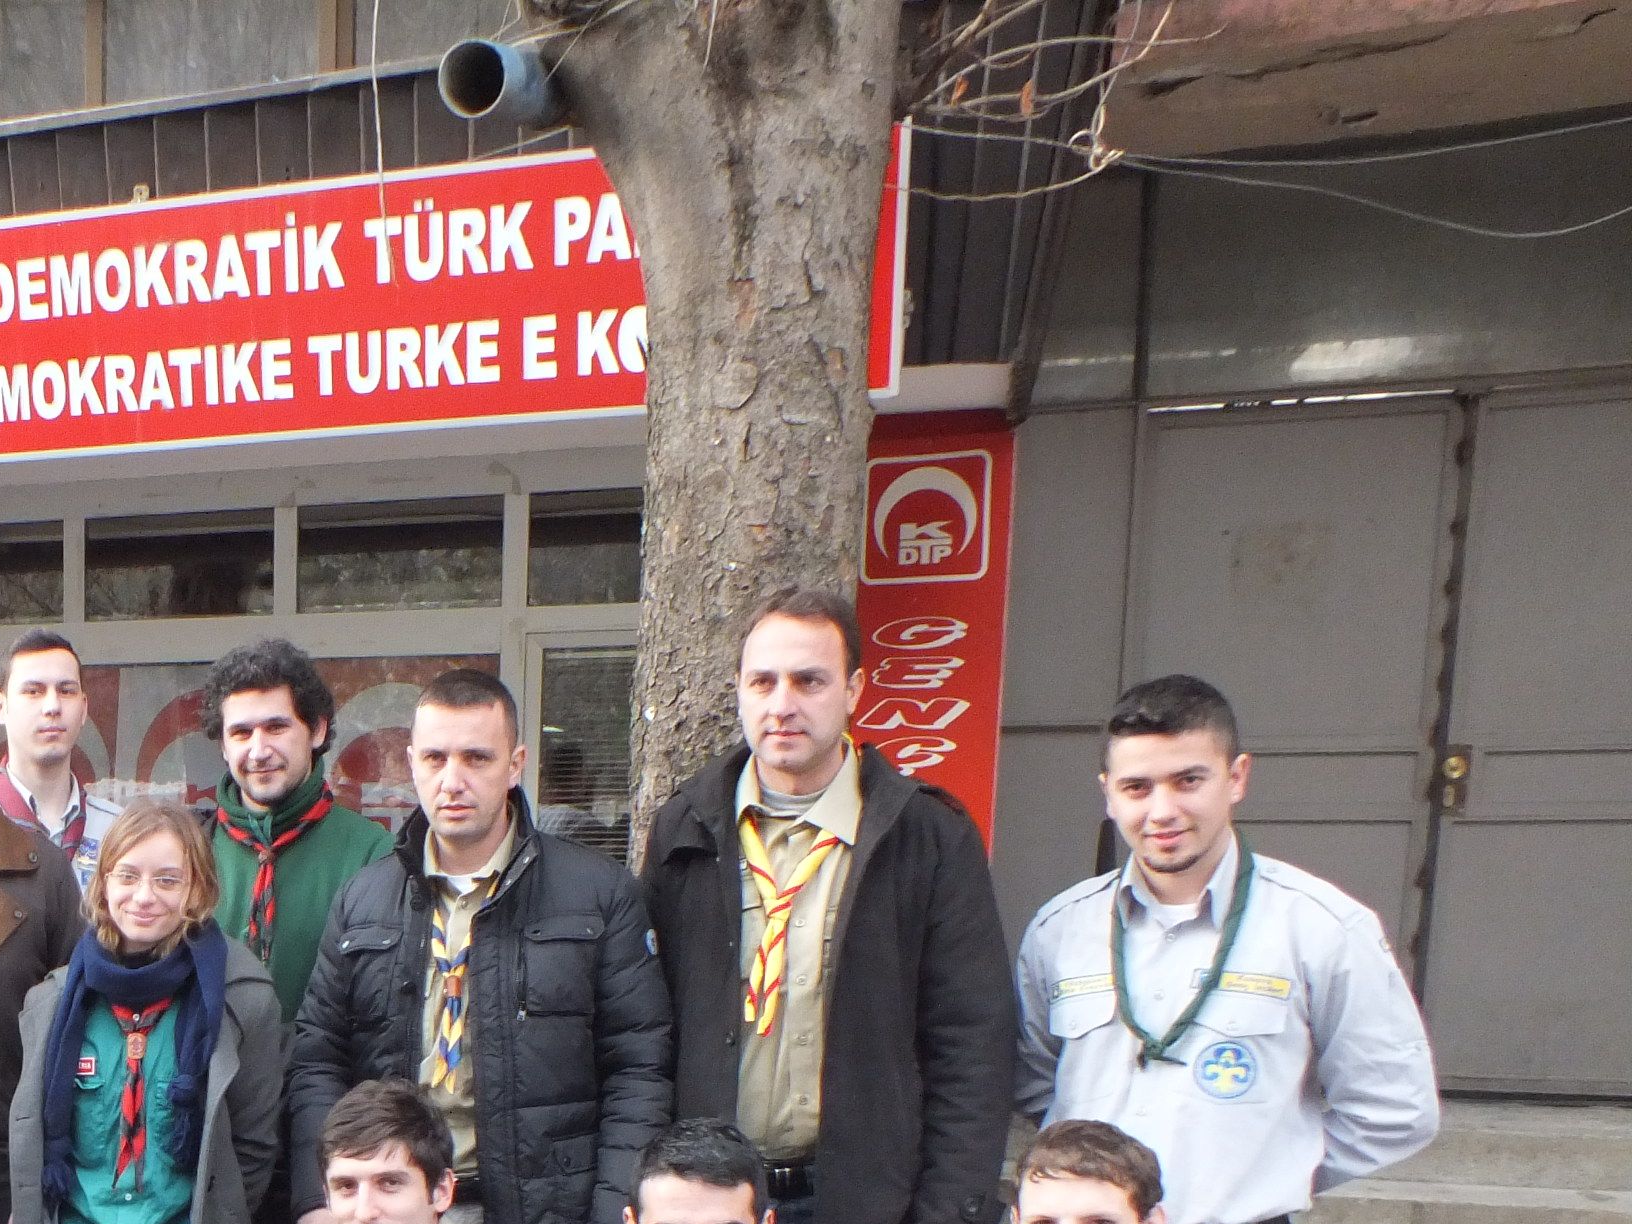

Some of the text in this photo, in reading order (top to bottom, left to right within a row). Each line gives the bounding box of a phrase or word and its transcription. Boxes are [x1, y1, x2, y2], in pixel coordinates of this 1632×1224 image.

[364, 196, 534, 285] TÜRK
[554, 192, 641, 267] PA
[307, 319, 500, 397] TURKE
[523, 313, 558, 381] E
[898, 540, 952, 566] DTP
